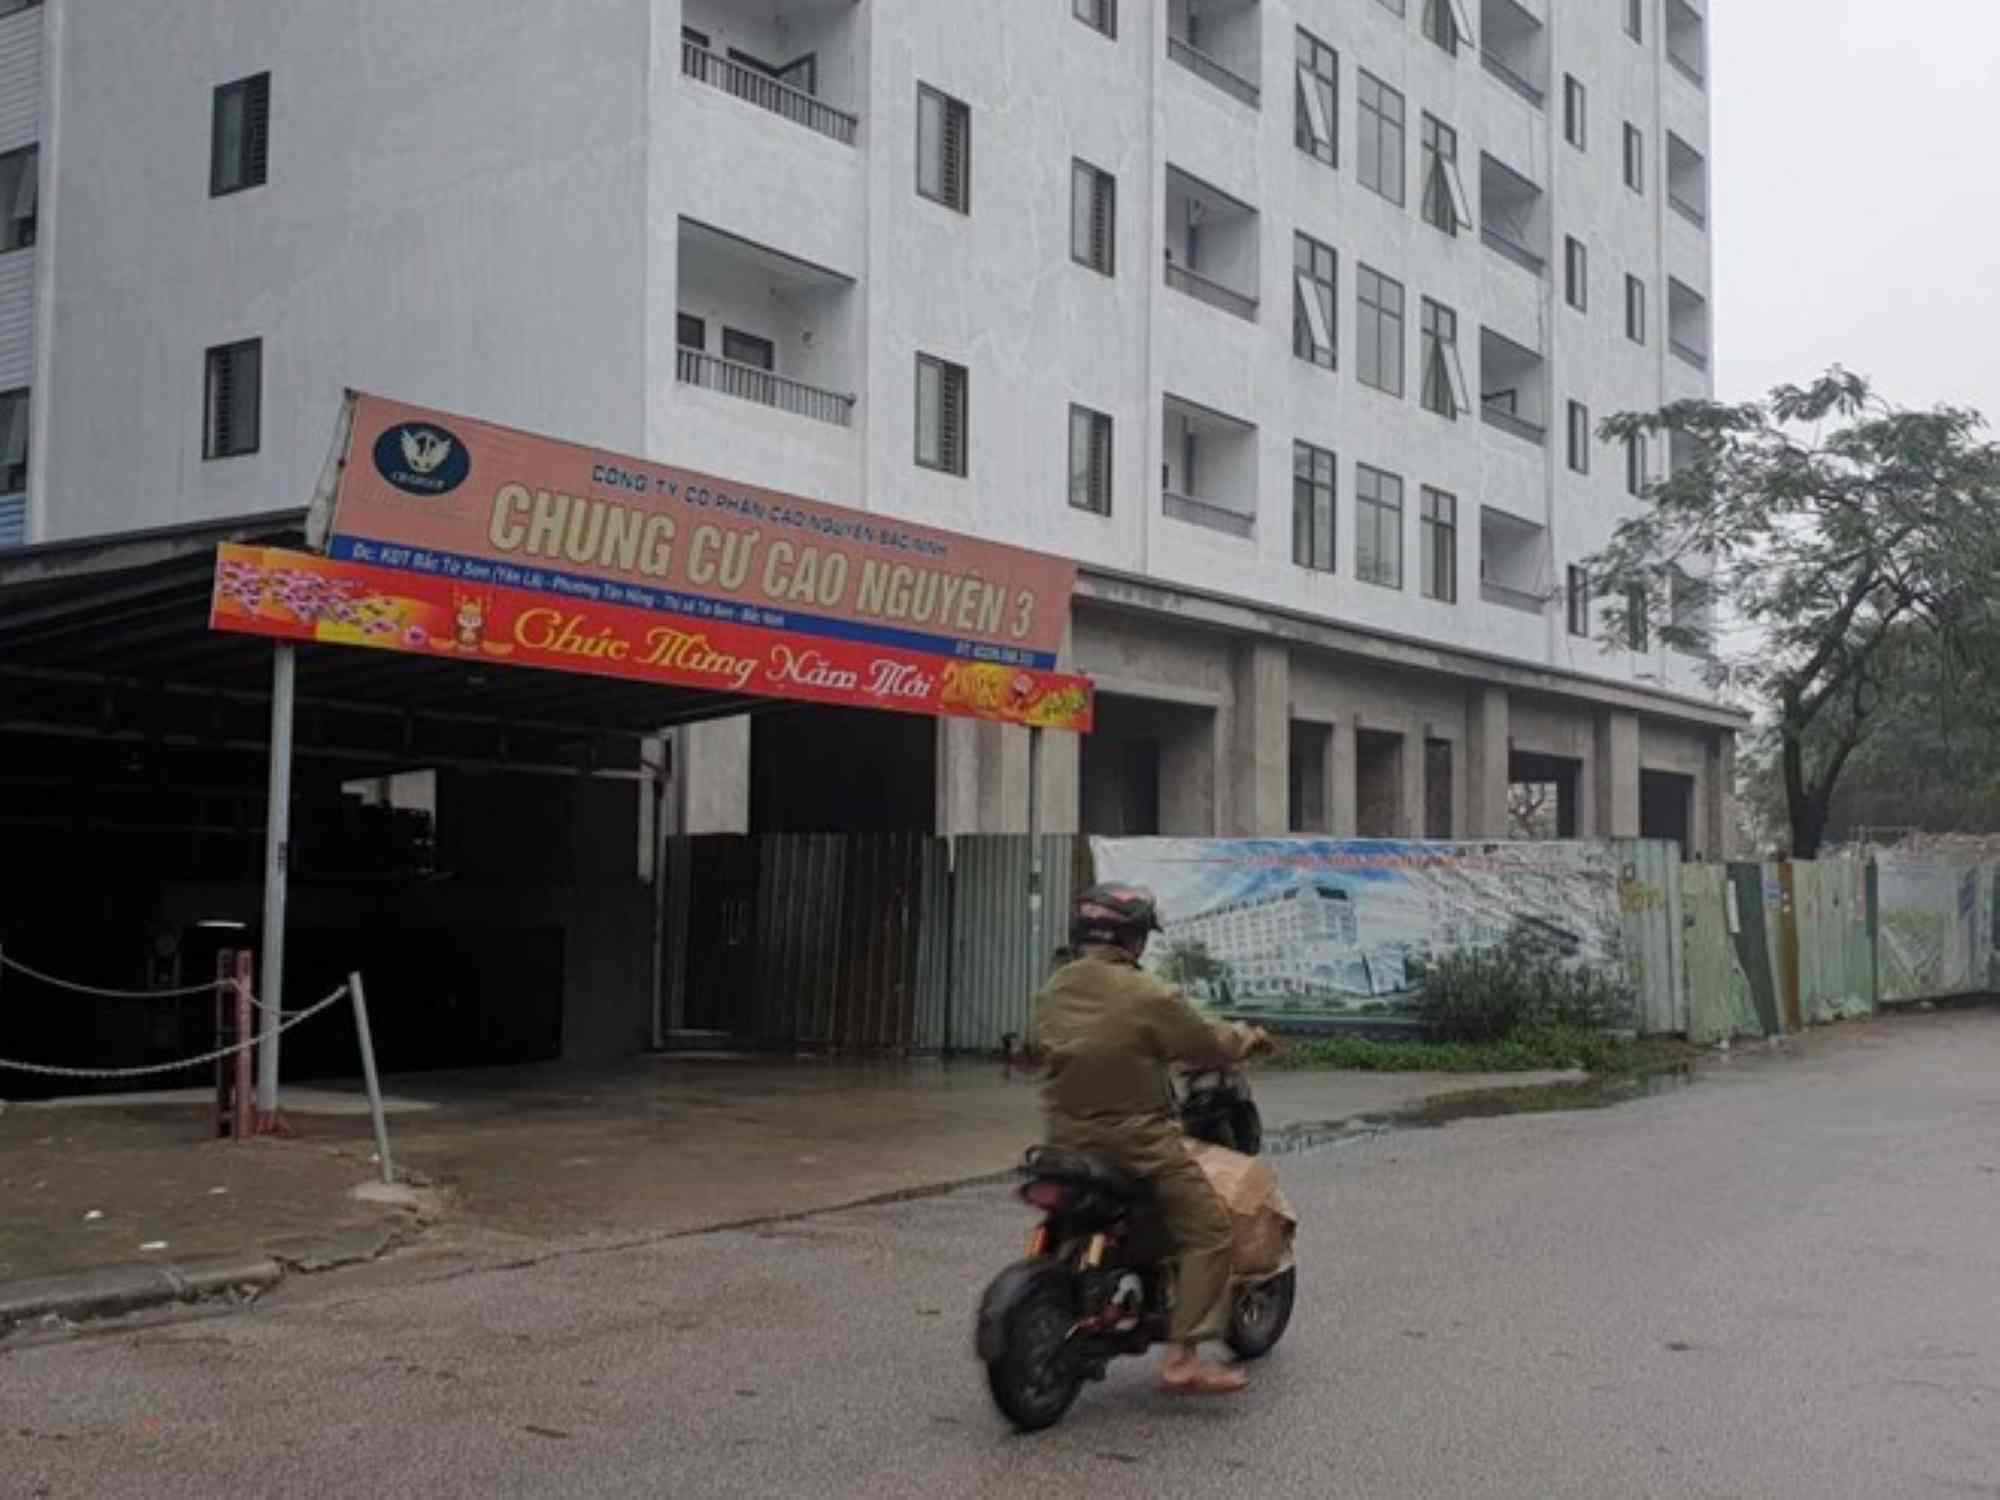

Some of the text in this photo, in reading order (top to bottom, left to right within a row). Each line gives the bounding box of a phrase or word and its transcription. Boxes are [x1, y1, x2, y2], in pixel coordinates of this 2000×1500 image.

[488, 481, 1035, 638] CHUNG CƯ CAO NGUYÊN 3
[514, 607, 630, 661] Chúc
[636, 625, 758, 690] Mừng
[766, 643, 858, 689] Năm
[863, 658, 935, 697] Mới
